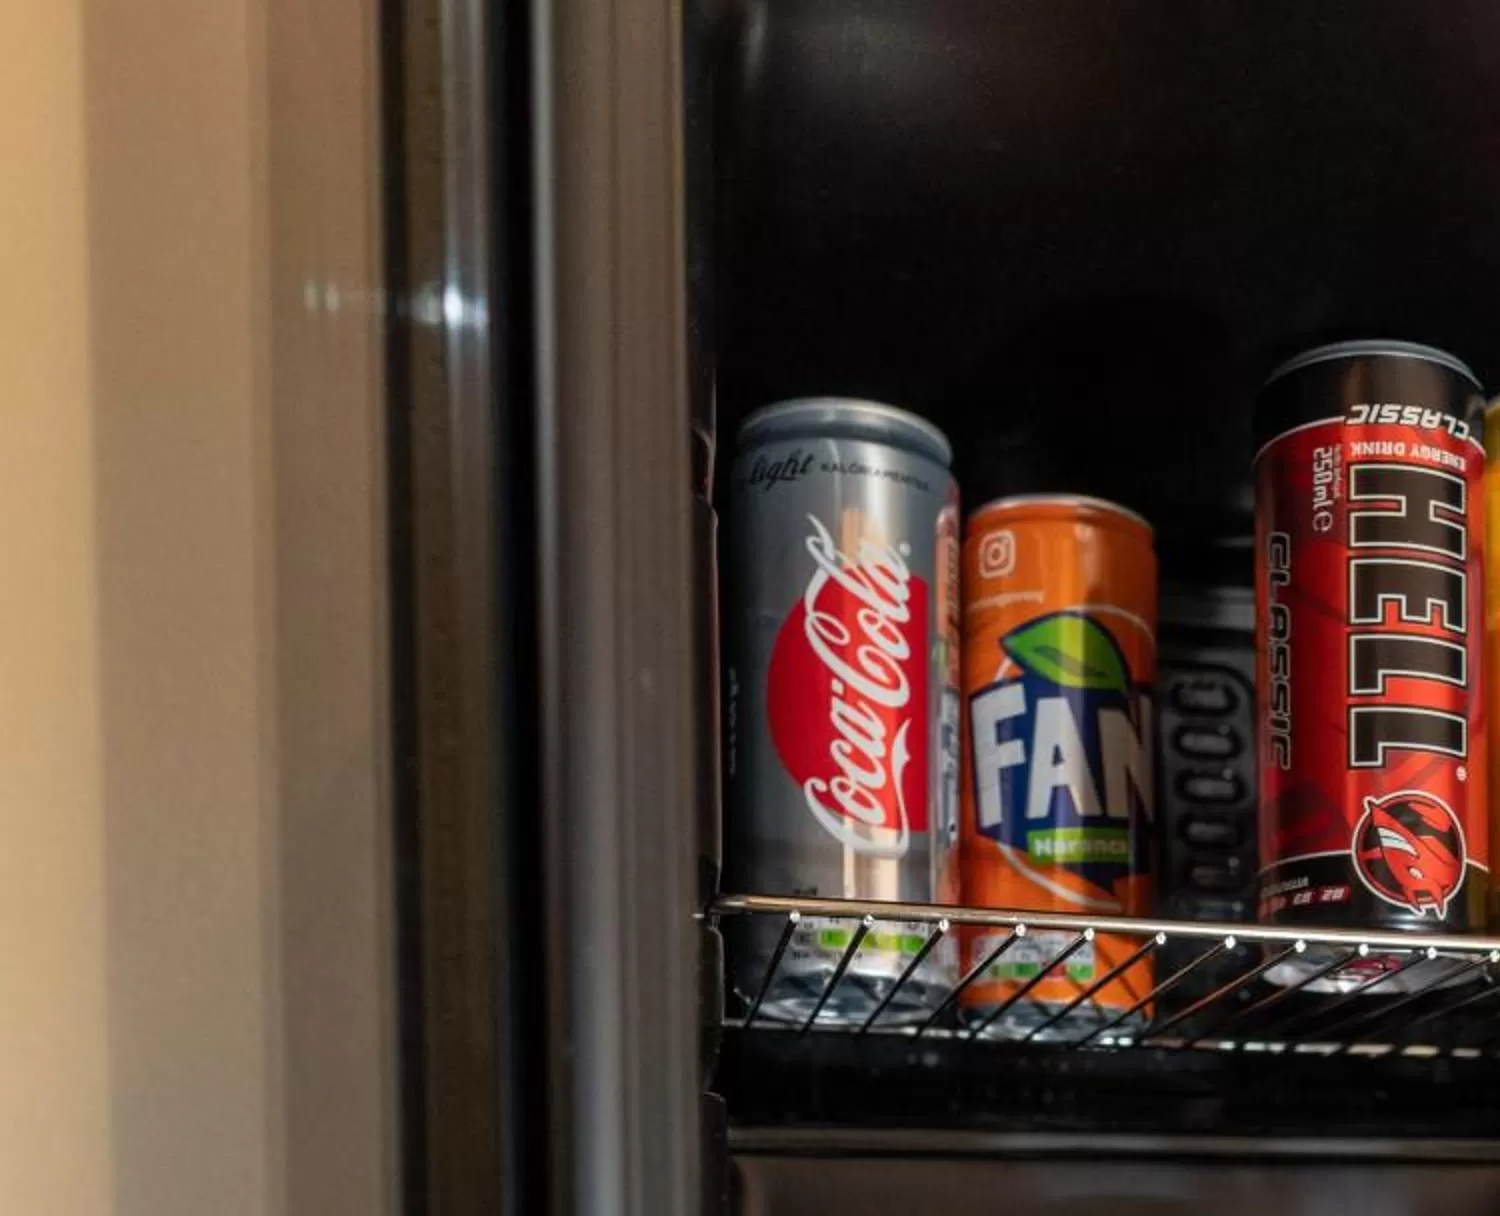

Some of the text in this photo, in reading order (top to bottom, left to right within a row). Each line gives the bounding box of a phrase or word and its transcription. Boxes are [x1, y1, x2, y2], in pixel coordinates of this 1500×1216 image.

[1346, 403, 1471, 442] CLASSIC
[1350, 441, 1467, 471] ENERGY DRINK
[1313, 447, 1334, 510] 250ml
[1348, 463, 1468, 770] HELL
[803, 512, 911, 856] Coca-Cola
[970, 682, 1156, 829] FAN
